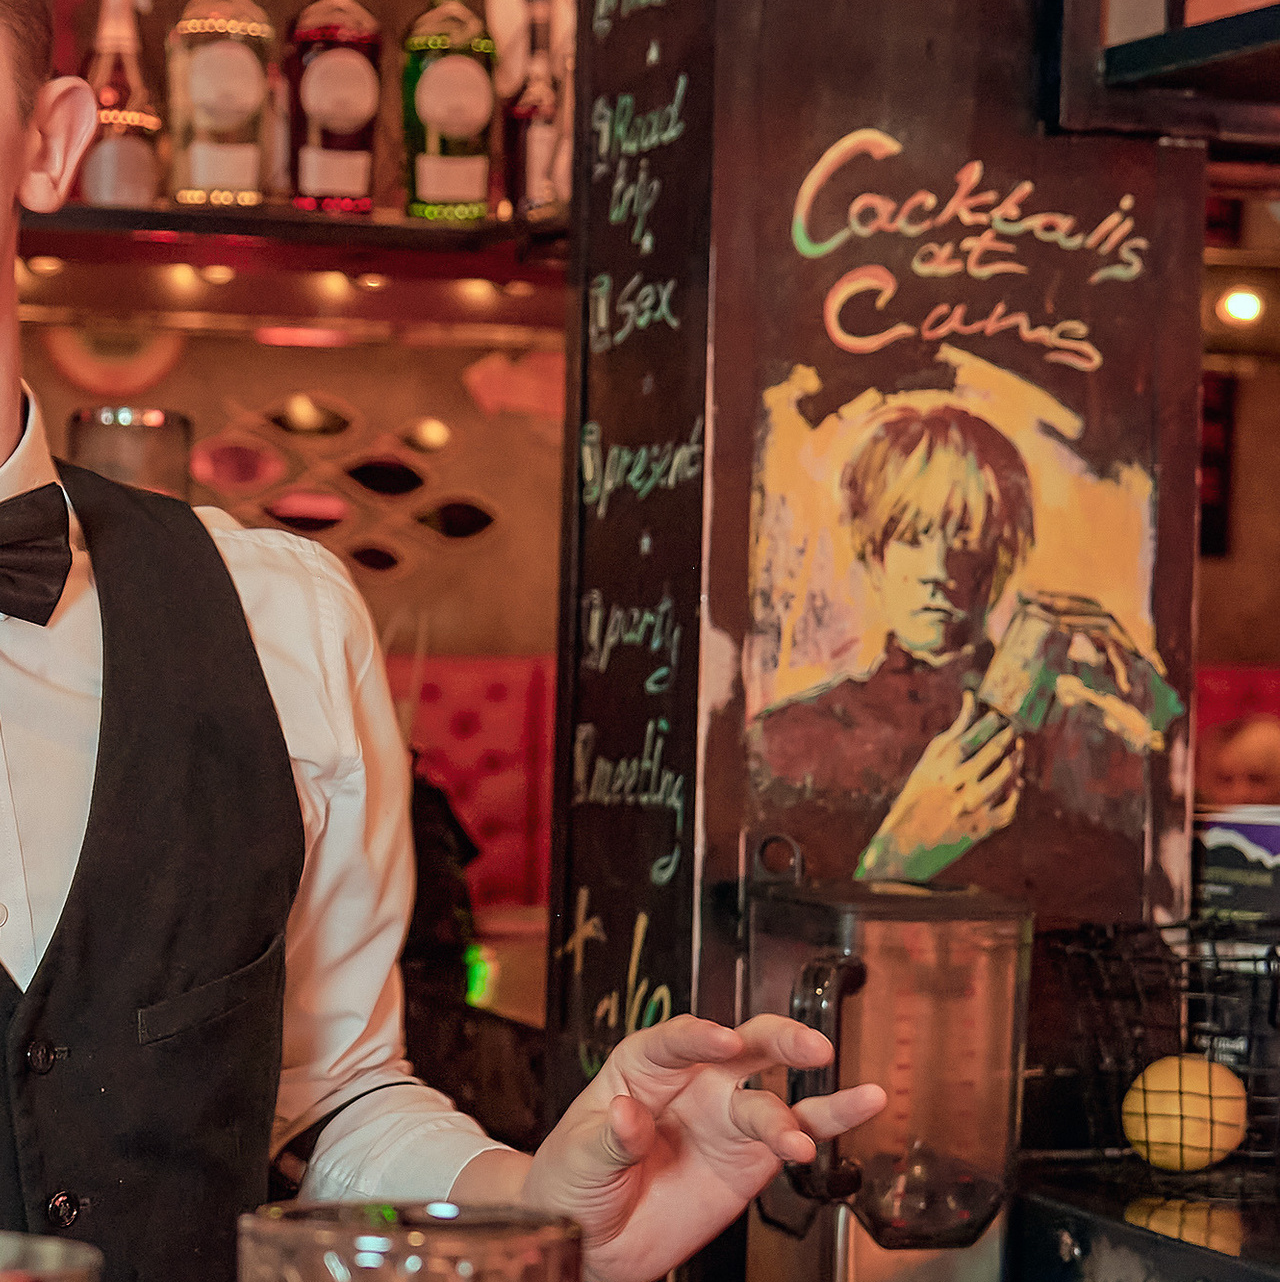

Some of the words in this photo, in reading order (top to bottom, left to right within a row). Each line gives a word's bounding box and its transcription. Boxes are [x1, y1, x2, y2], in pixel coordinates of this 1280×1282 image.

[791, 127, 1150, 285] Cocktails
[911, 228, 1028, 280] at
[613, 272, 681, 345] Sex
